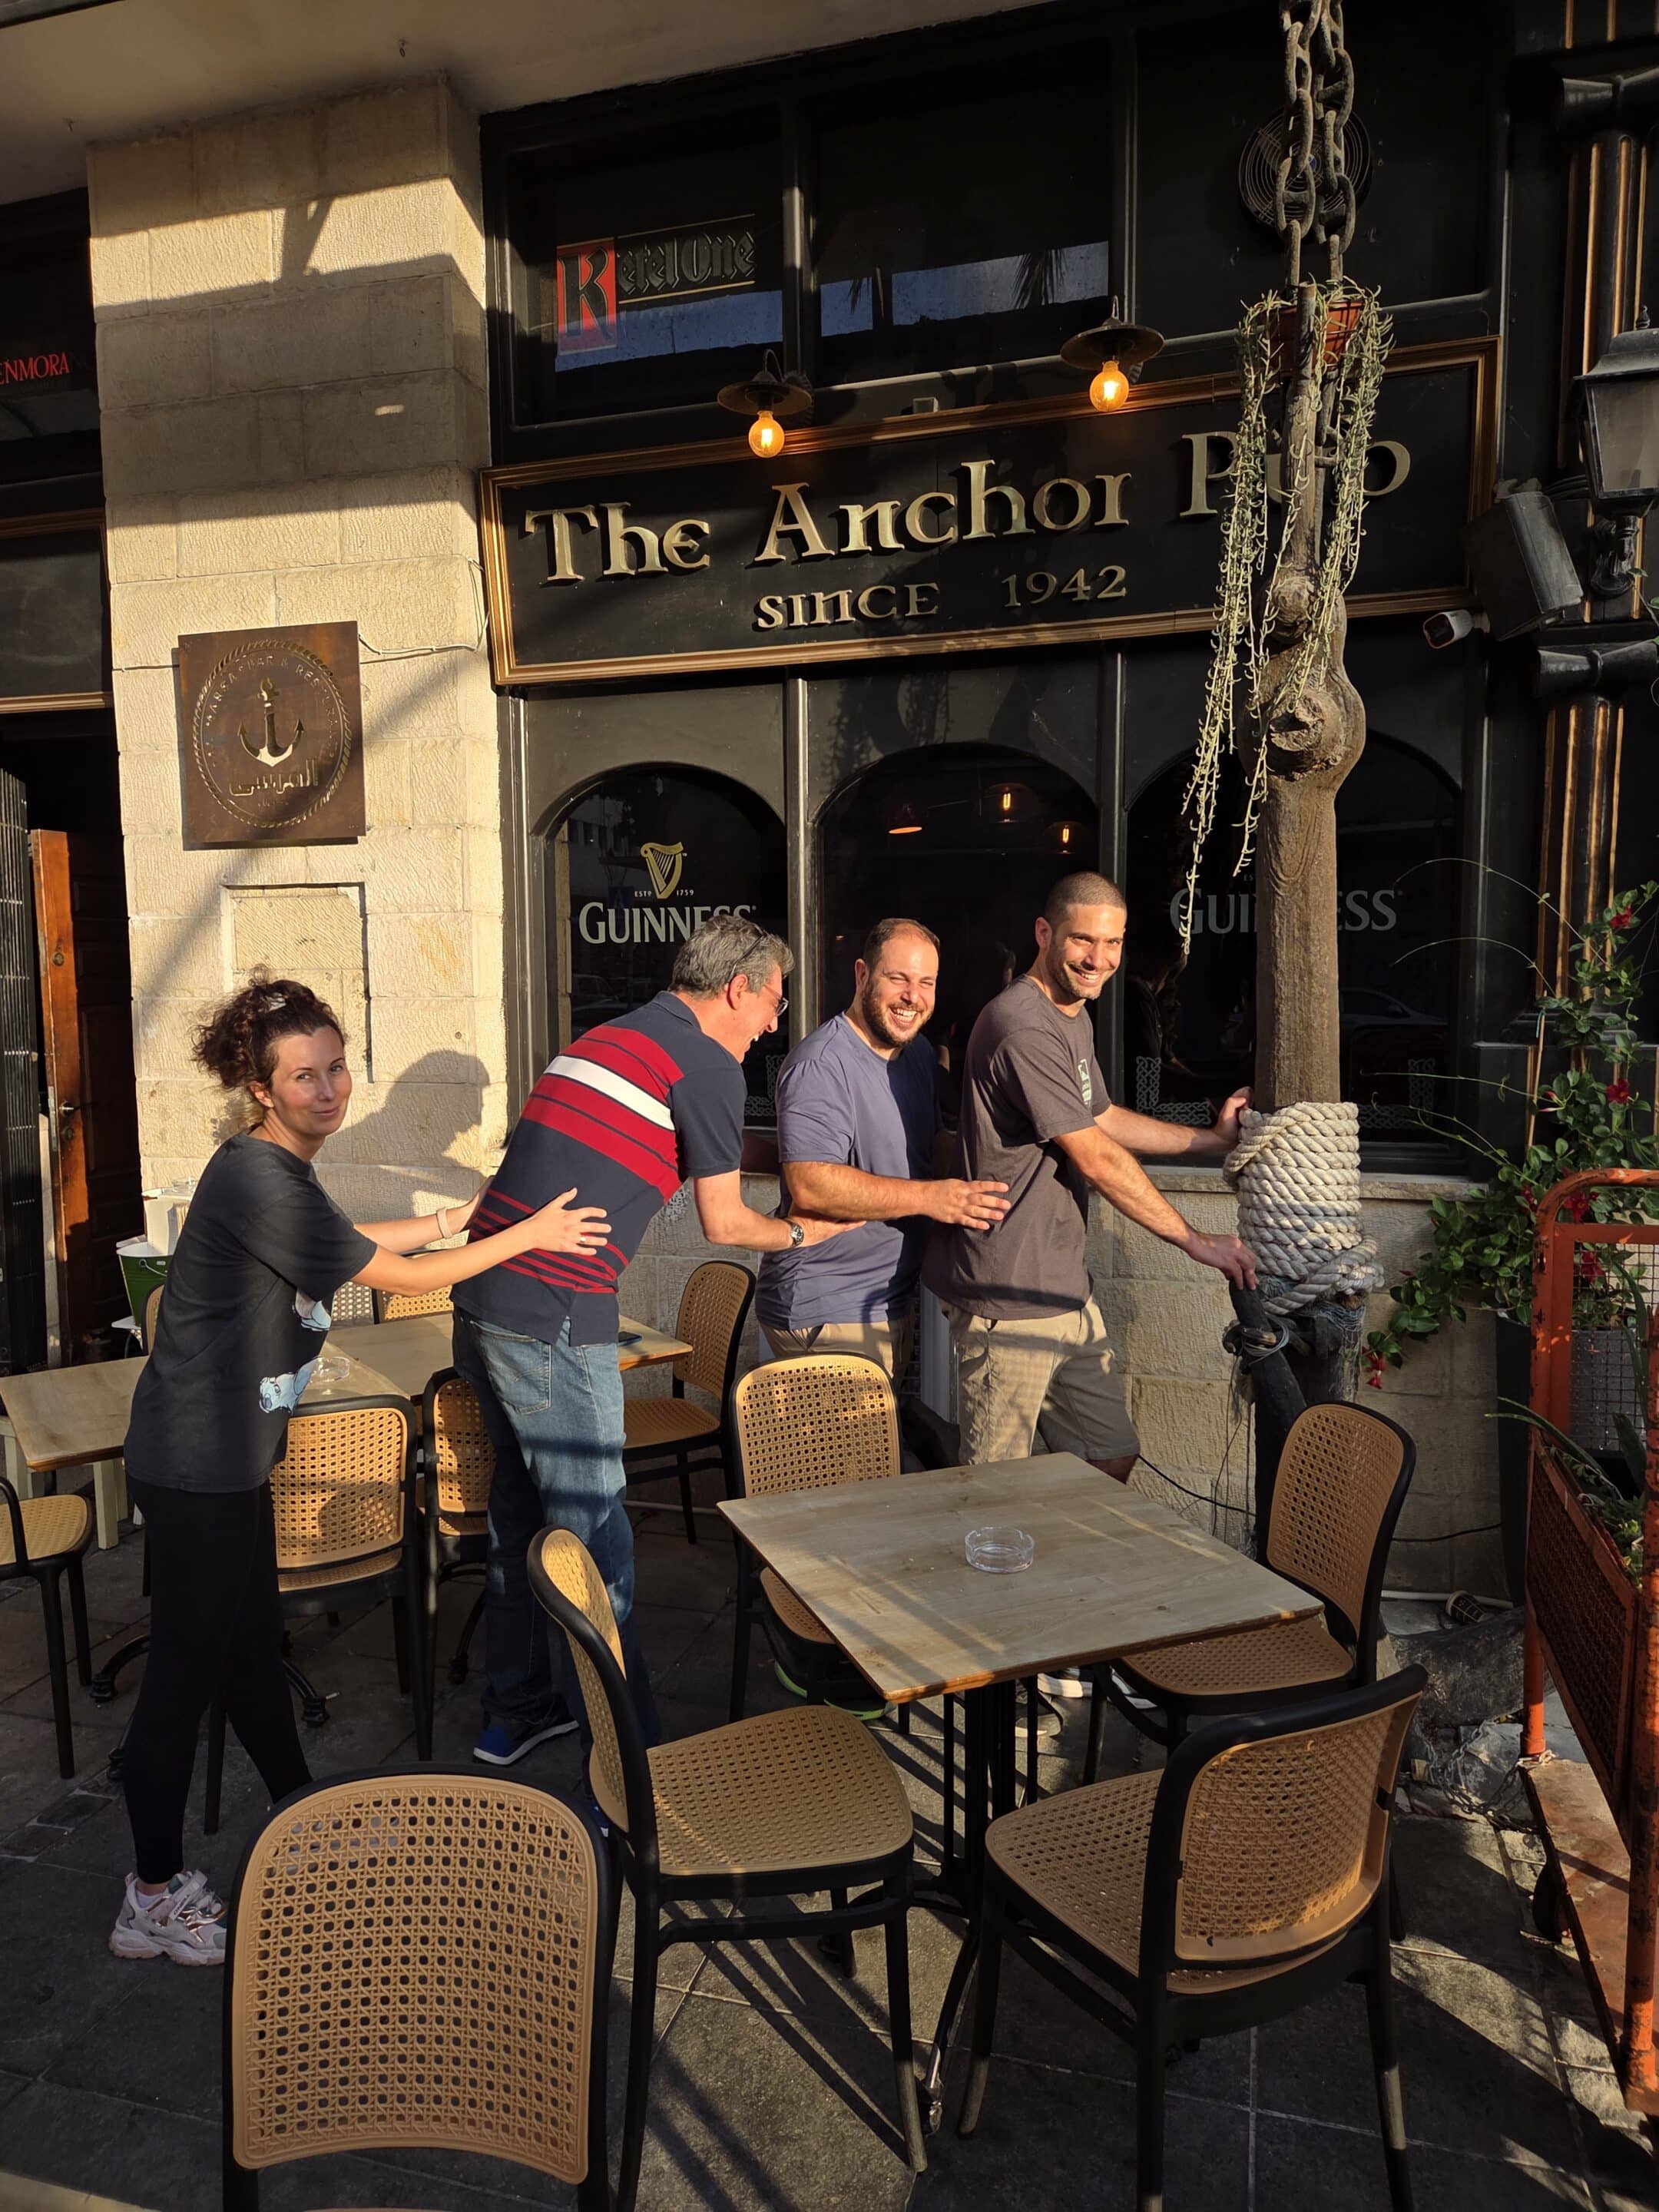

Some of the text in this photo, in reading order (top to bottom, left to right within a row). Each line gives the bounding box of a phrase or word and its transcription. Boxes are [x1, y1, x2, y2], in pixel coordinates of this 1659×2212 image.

[525, 501, 710, 581] The
[754, 459, 1132, 562] Anchor
[1002, 565, 1128, 608] 1942
[676, 889, 694, 897] 1759
